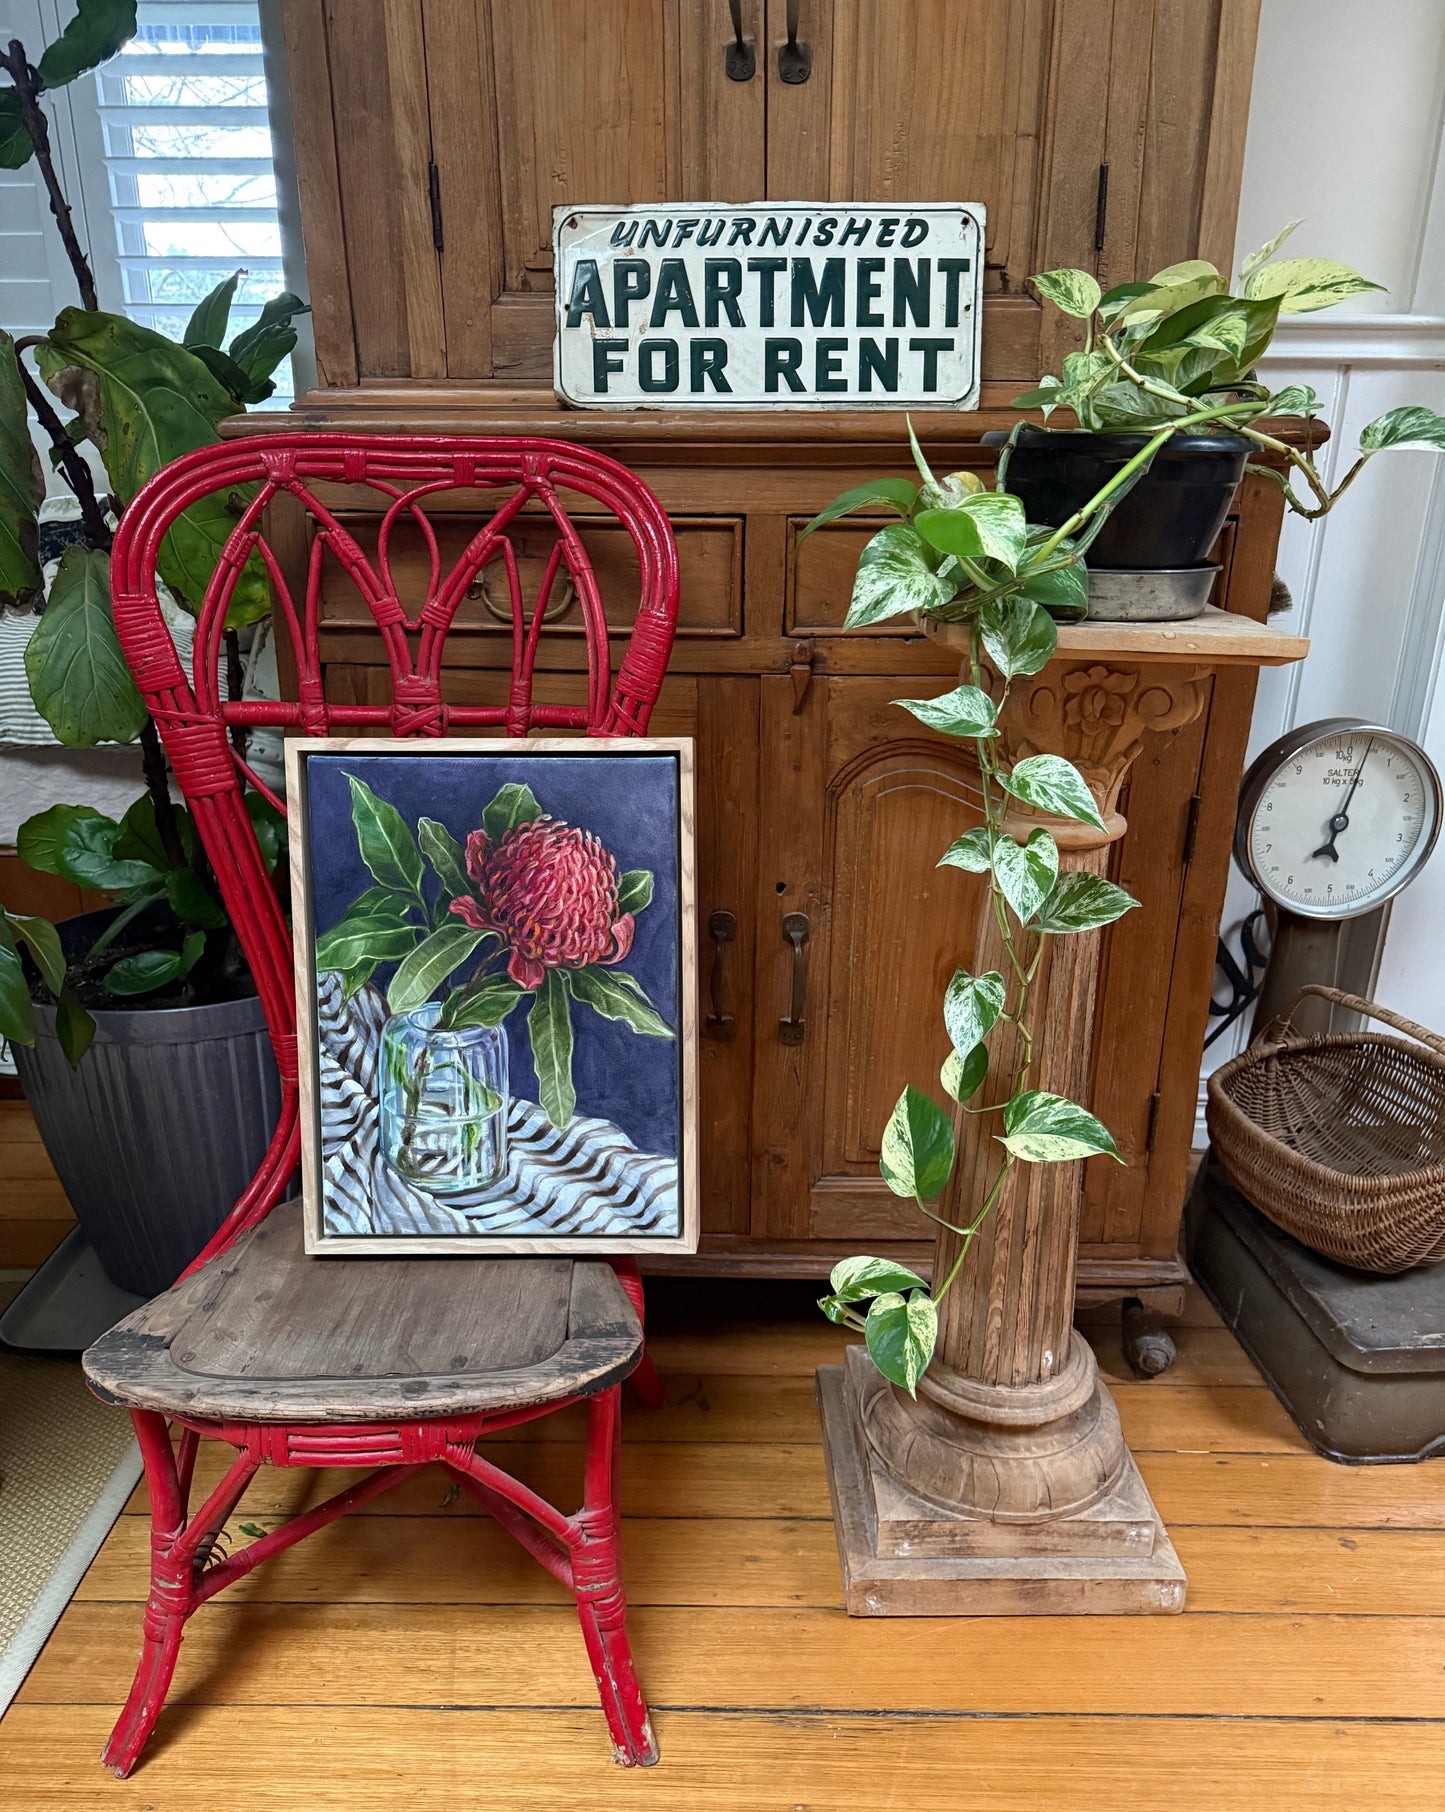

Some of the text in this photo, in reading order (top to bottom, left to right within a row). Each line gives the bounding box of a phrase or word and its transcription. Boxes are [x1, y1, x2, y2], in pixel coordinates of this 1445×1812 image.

[610, 217, 929, 248] UNFURNISHED
[566, 257, 971, 328] APARTMENT
[593, 337, 955, 393] FOR RENT
[1295, 765, 1302, 775] 9
[1327, 768, 1360, 777] SALTER
[1322, 777, 1330, 785] 10
[1331, 778, 1340, 787] kg
[1403, 793, 1410, 802] 2
[1266, 802, 1273, 811] 8
[1396, 833, 1403, 842] 3
[1265, 844, 1272, 853] 7
[1368, 868, 1374, 877] 4
[1287, 875, 1294, 884] 6
[1326, 884, 1333, 893] 5
